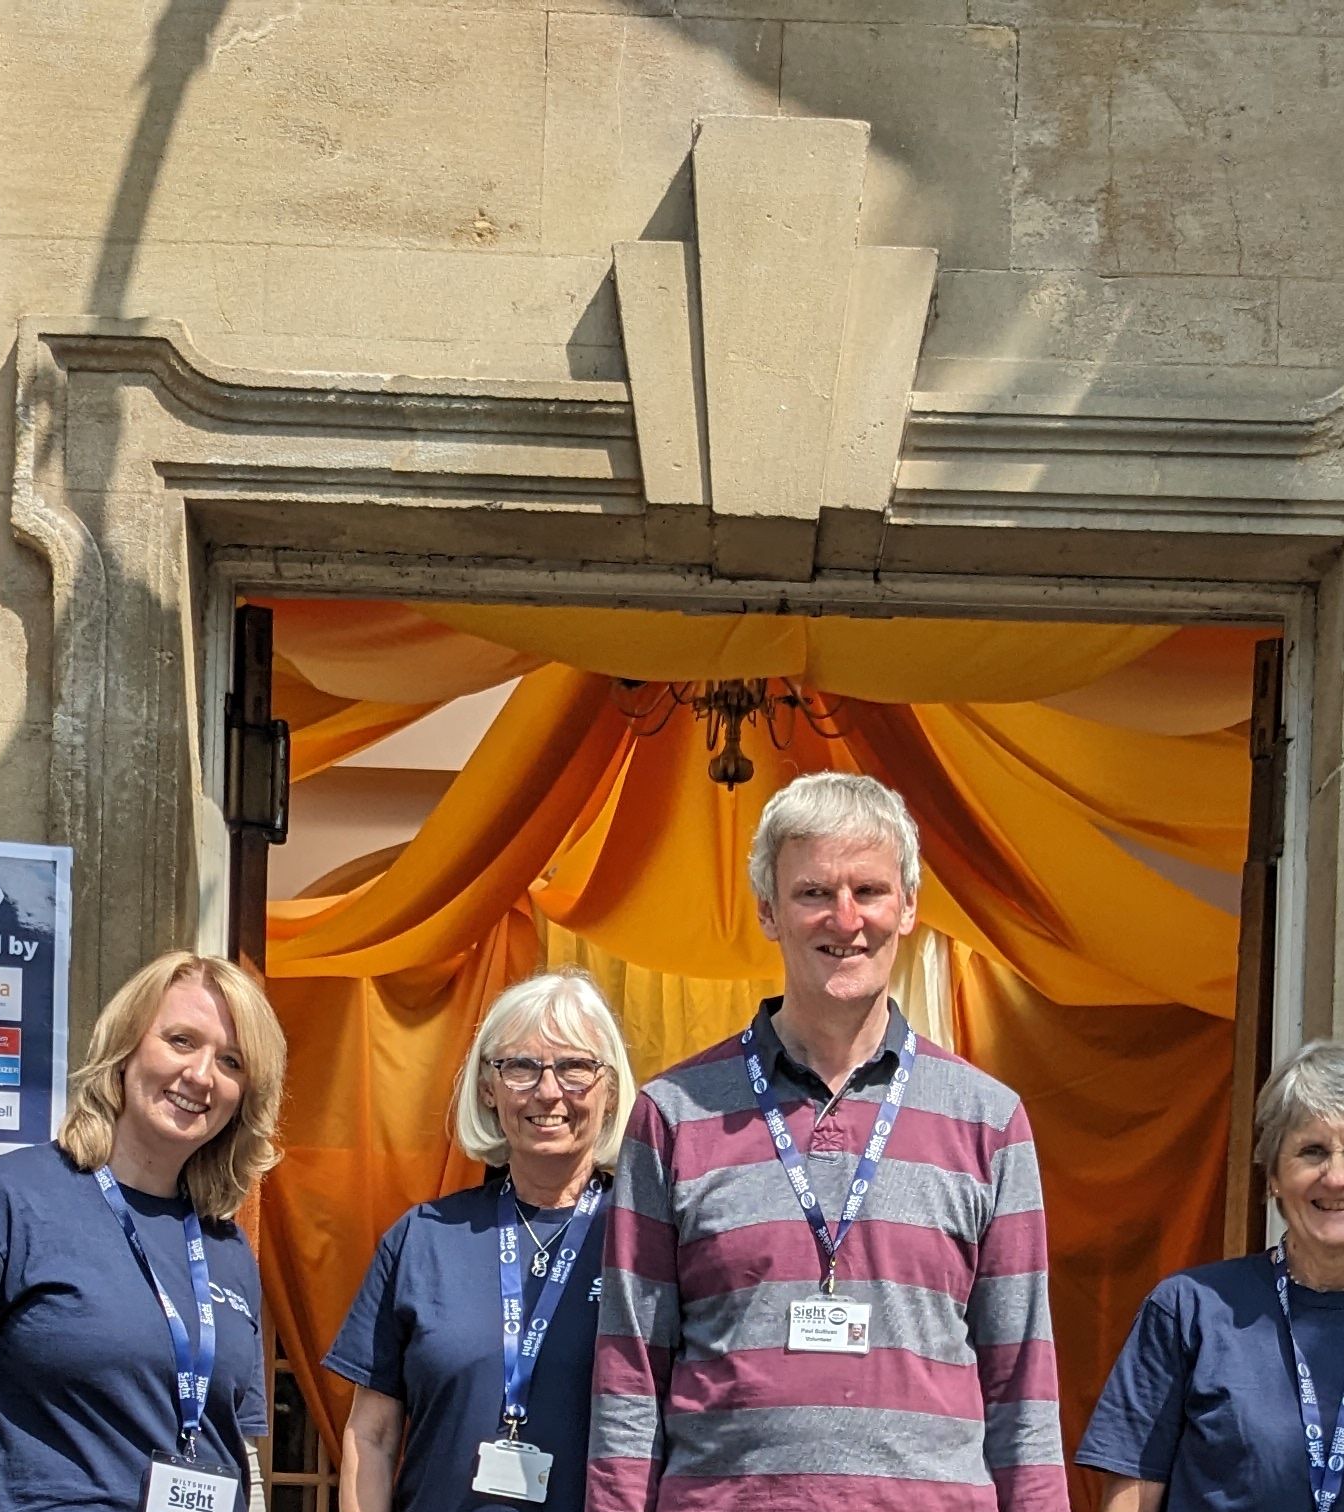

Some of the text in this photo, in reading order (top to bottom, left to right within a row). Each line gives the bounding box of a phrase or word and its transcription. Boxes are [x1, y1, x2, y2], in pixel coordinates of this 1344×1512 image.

[9, 936, 39, 961] by
[793, 1305, 826, 1320] Sight
[172, 1477, 216, 1491] WILTSHIRE
[168, 1485, 214, 1512] Sight
